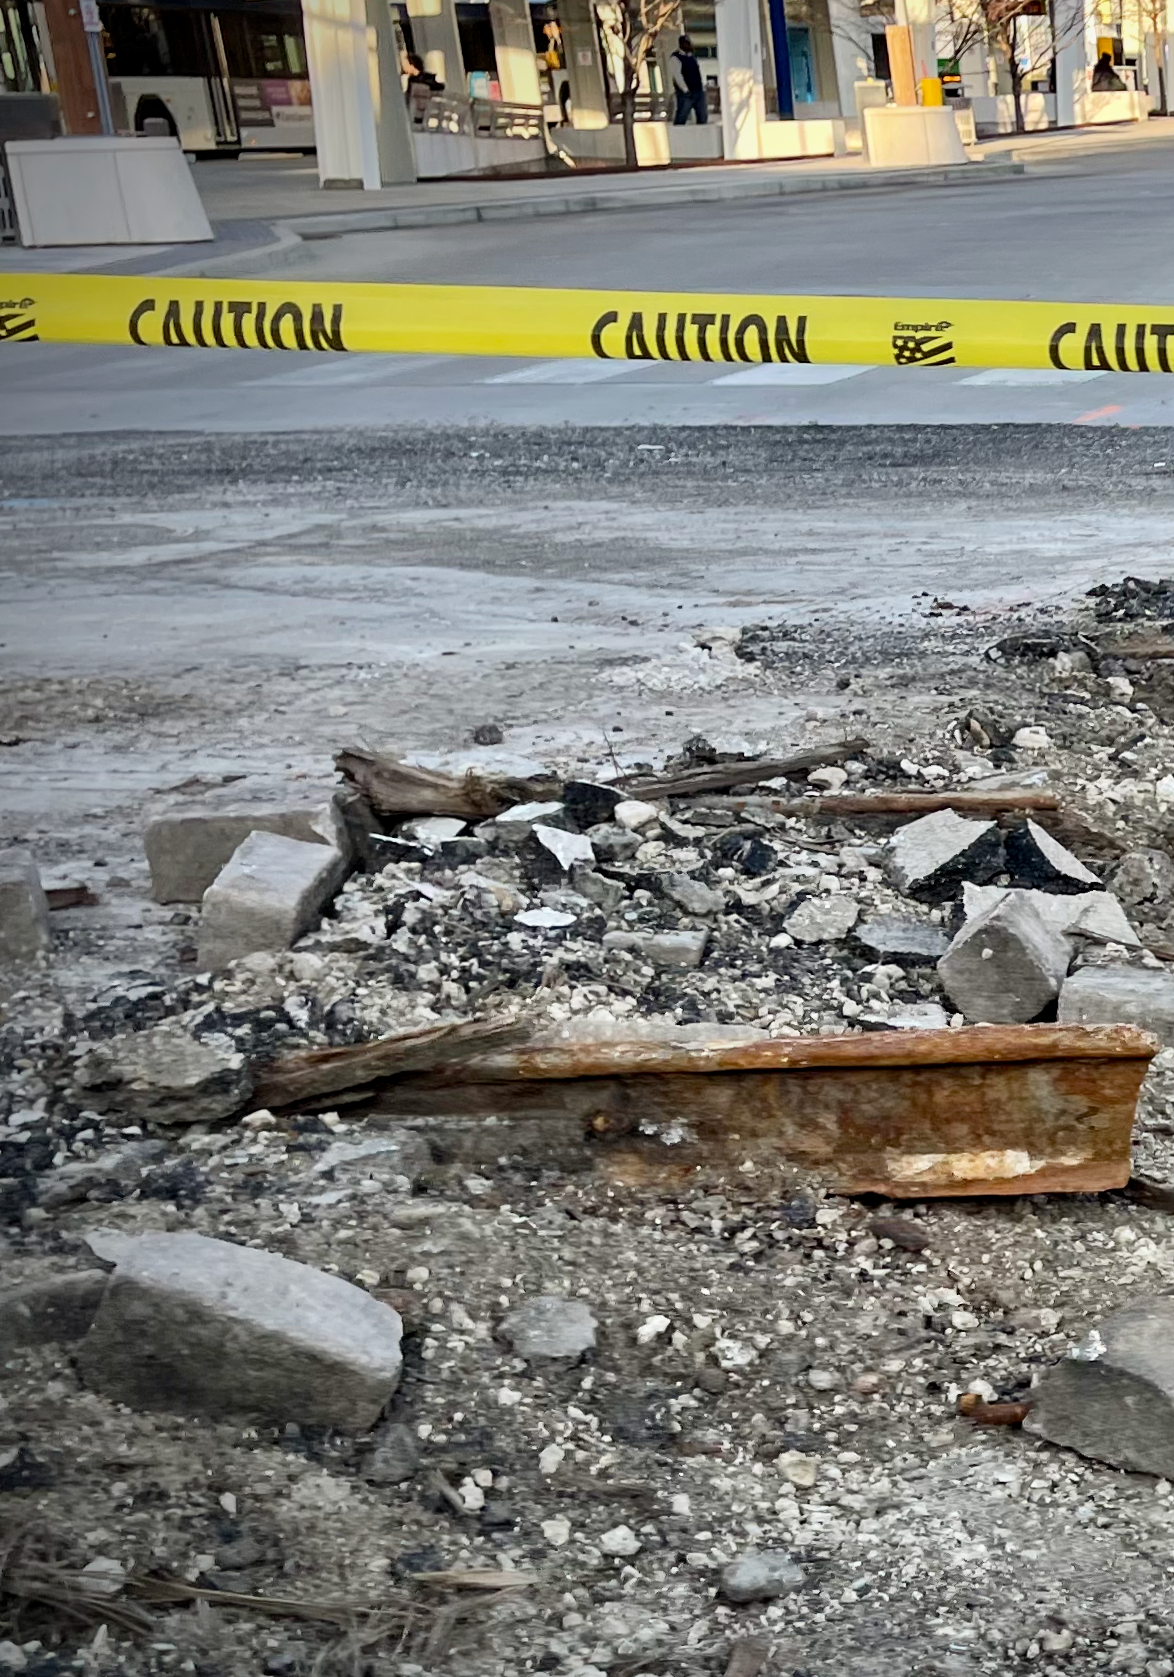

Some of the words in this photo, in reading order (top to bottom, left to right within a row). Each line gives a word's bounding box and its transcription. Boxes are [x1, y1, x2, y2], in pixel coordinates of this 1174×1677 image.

[129, 299, 348, 352] CAUTION
[591, 311, 812, 364] CAUTION
[894, 321, 952, 333] Empire
